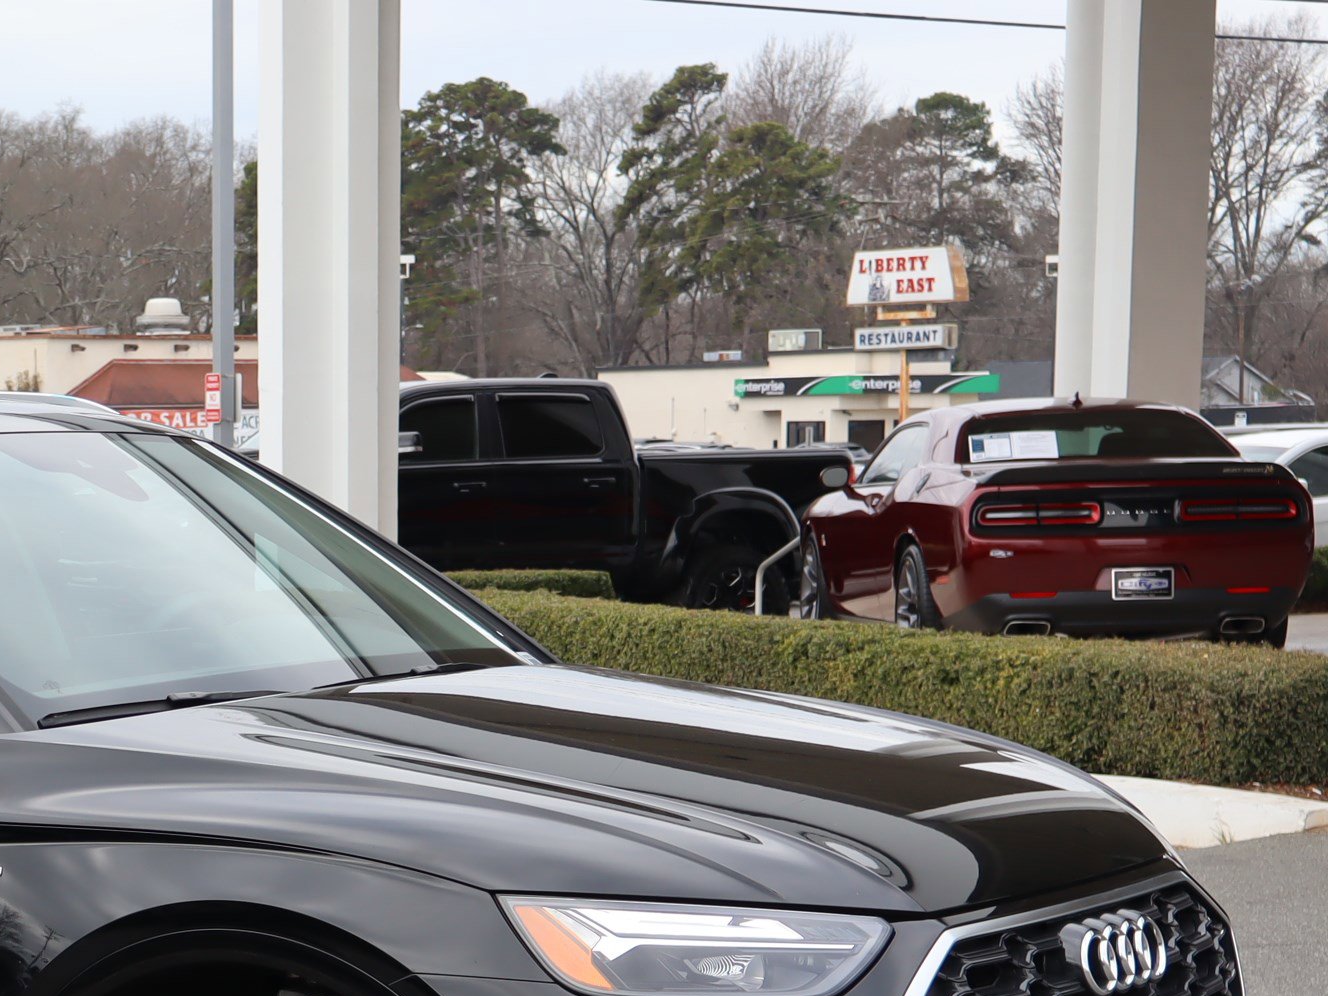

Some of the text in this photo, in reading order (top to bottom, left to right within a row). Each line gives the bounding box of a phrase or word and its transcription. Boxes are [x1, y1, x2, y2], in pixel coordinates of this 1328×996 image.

[896, 277, 936, 294] EAST
[859, 330, 939, 346] RESTAURANT
[736, 380, 785, 394] enterprise
